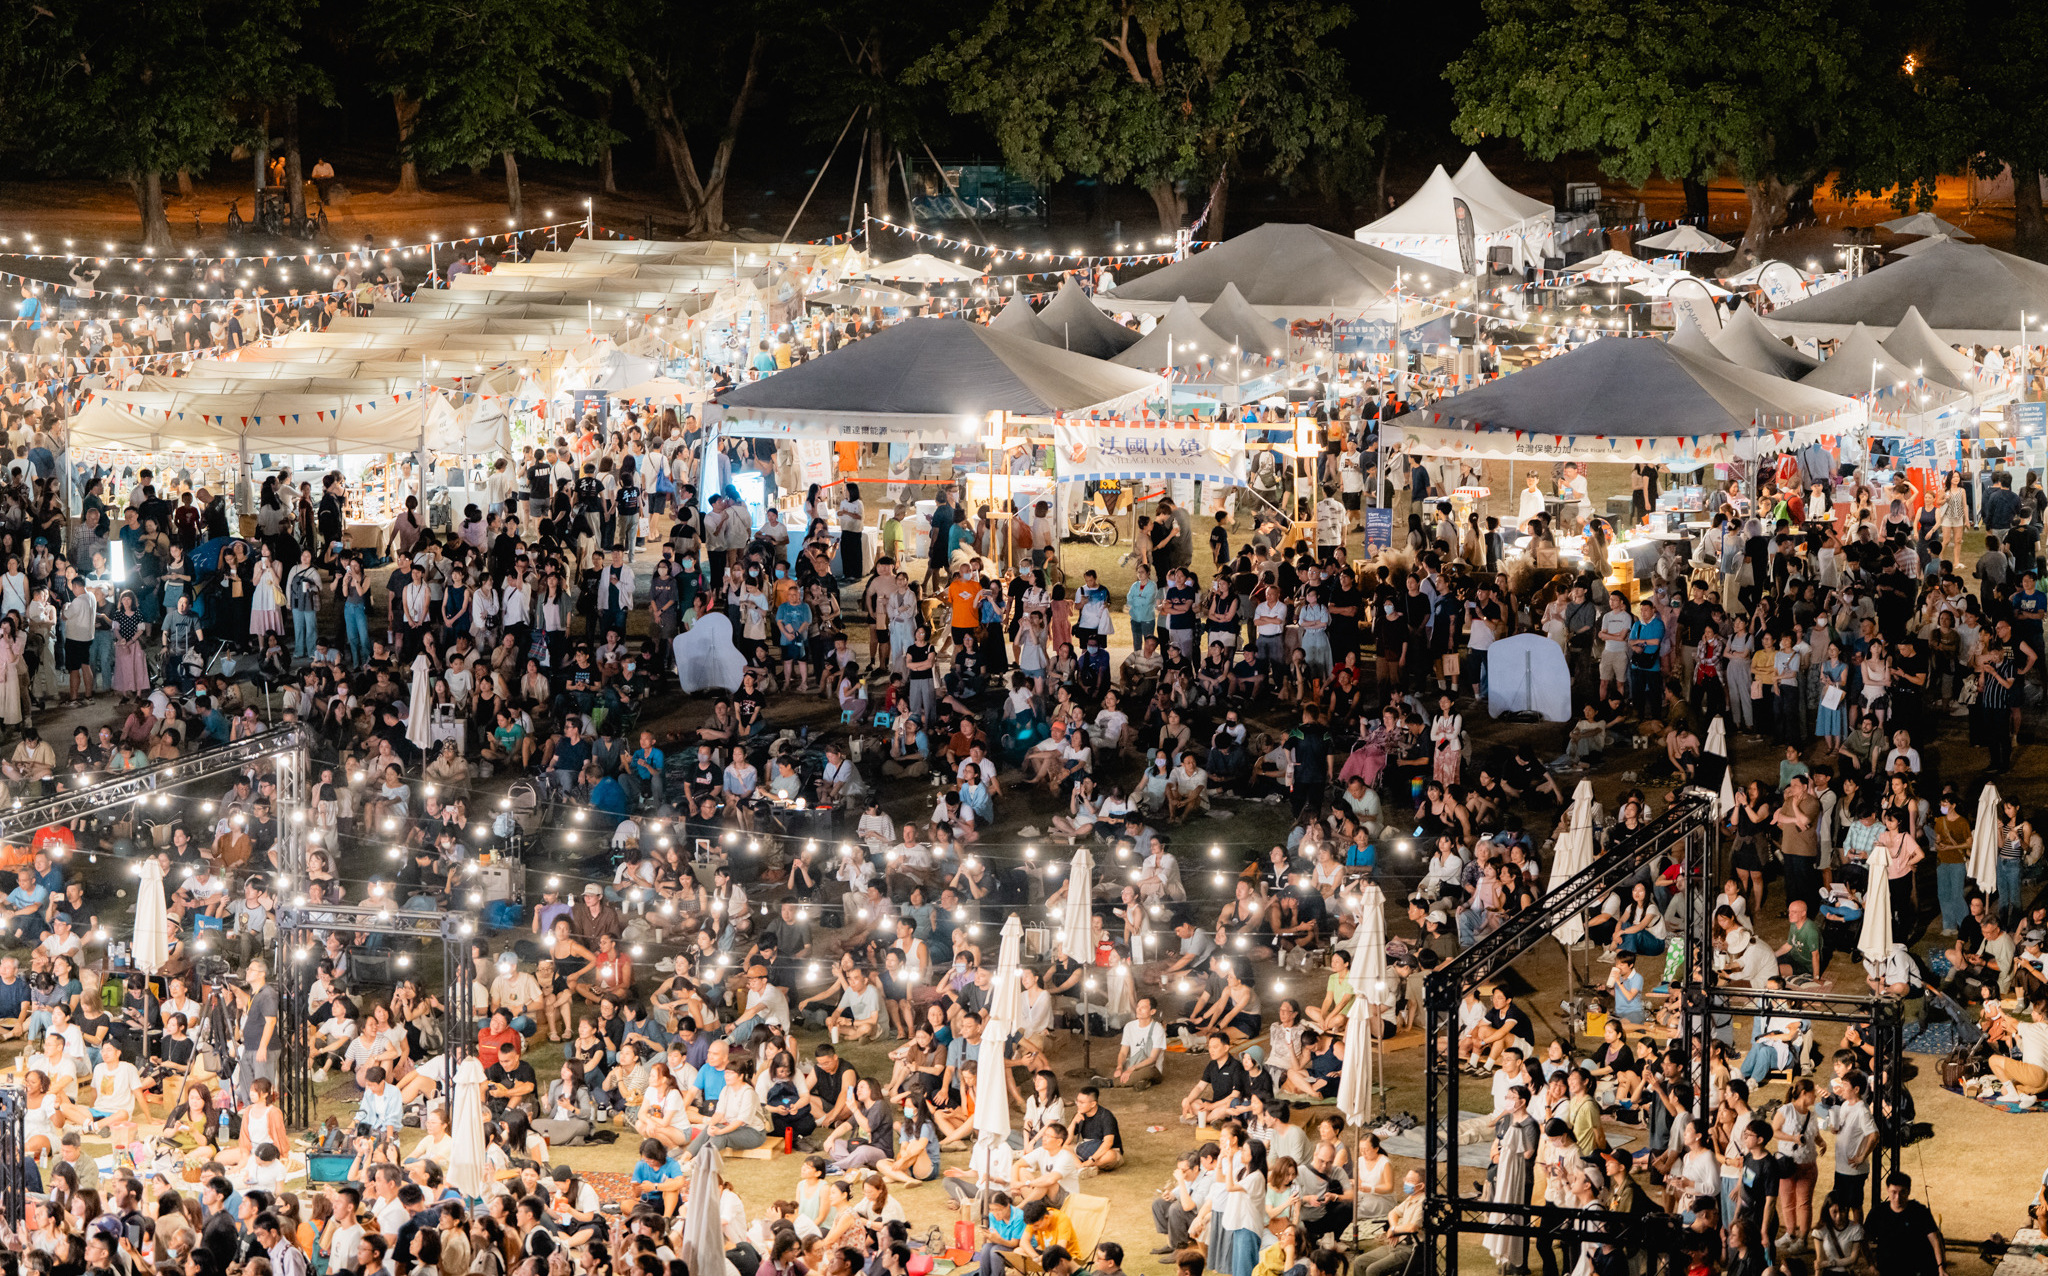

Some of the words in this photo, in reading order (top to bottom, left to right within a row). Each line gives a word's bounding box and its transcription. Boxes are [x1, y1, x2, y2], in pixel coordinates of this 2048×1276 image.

[843, 425, 888, 435] 道達爾能源
[1099, 436, 1202, 457] 法國小鎮
[1516, 443, 1572, 454] 台灣保樂力加
[1111, 457, 1149, 465] VILLAGE
[1151, 457, 1195, 466] FRANÇAIS
[974, 497, 999, 508] Lets
